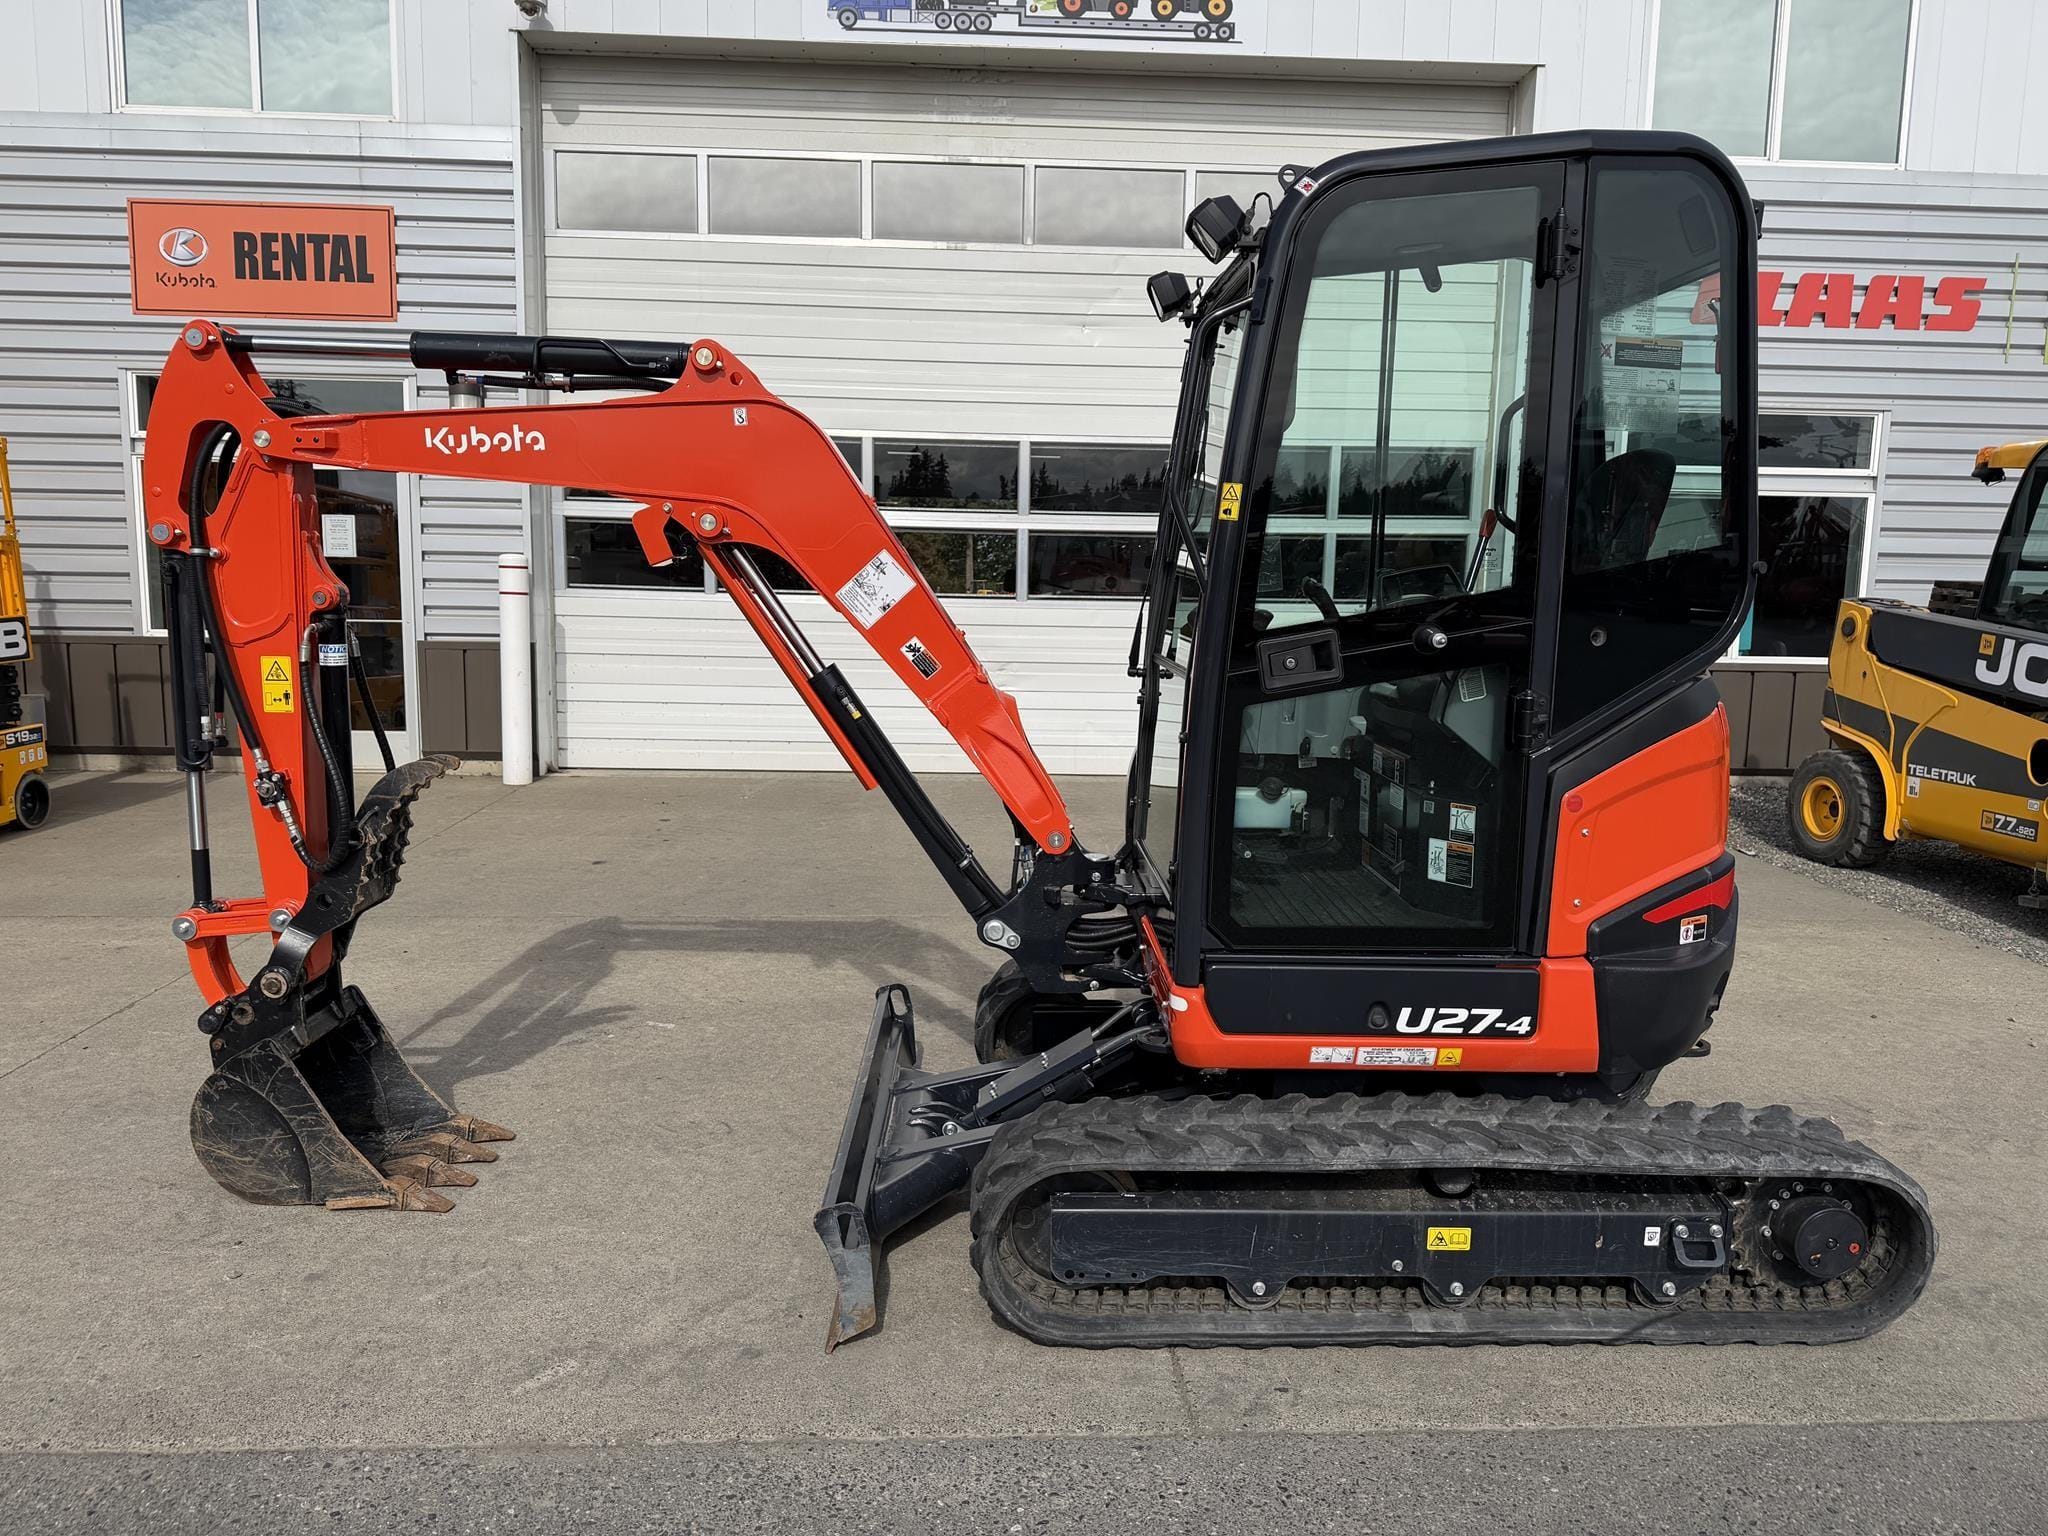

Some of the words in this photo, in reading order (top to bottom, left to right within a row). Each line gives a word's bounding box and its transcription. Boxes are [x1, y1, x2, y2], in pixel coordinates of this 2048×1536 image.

[233, 231, 375, 284] RENTAL
[156, 271, 217, 289] Kubota
[424, 424, 546, 455] Kubota
[1908, 763, 1977, 787] TELETRUK
[1396, 1007, 1532, 1035] U27-4
